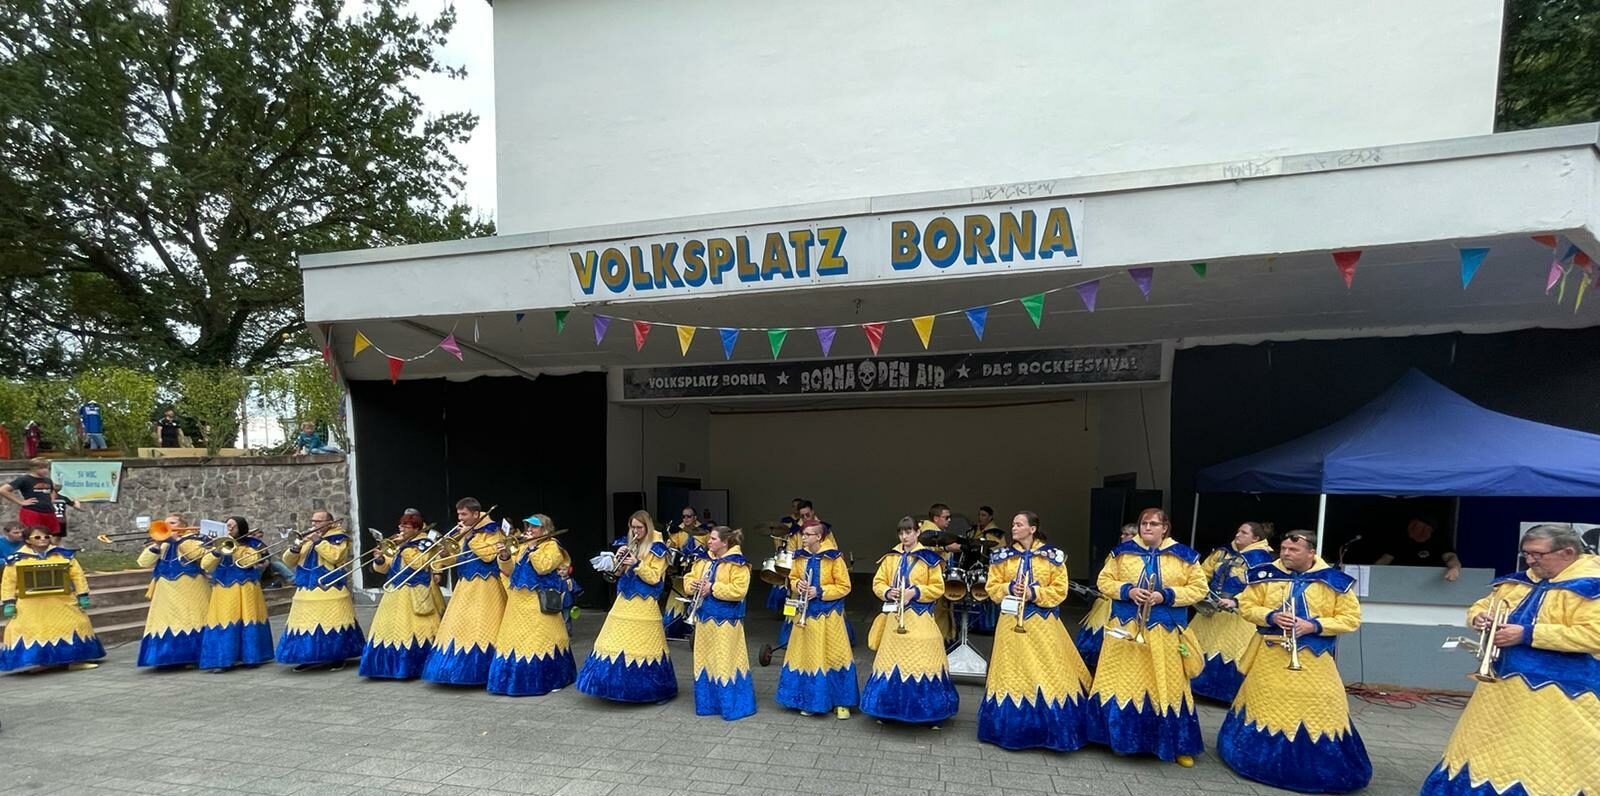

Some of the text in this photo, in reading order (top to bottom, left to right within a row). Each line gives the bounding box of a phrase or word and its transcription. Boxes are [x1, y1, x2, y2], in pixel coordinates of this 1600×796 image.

[570, 207, 1079, 295] VOLKSPLATZ BORNA
[801, 363, 855, 393] BORNA
[916, 363, 945, 389] AIR
[982, 357, 1138, 377] DAS ROCKFESTIVAL
[649, 372, 767, 389] VOLKSPLATZ BORNA
